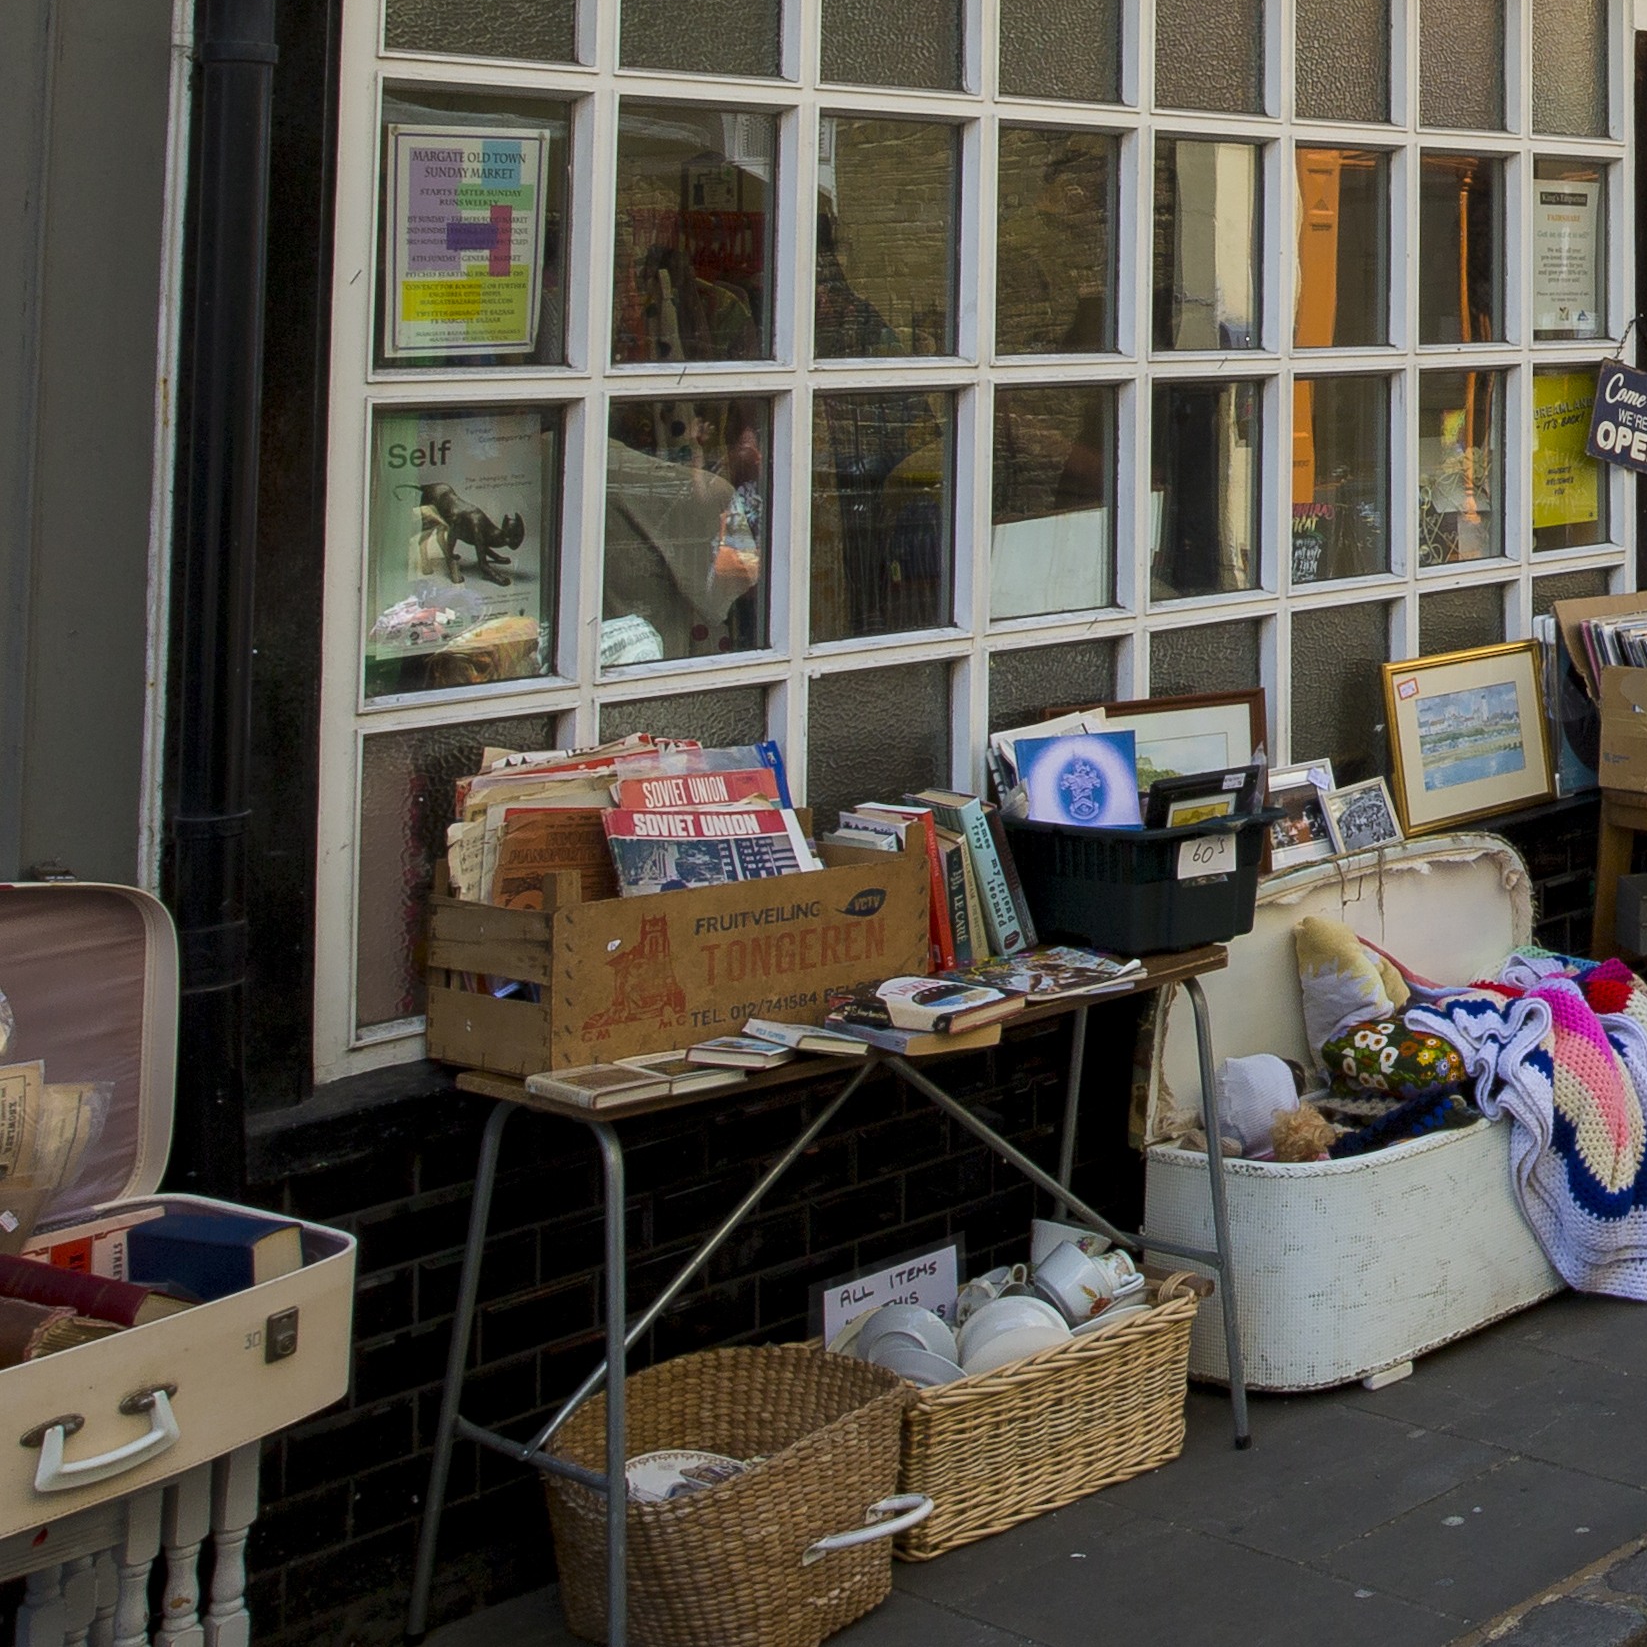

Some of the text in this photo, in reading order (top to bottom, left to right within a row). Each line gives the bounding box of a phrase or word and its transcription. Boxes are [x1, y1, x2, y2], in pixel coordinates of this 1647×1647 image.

[412, 151, 527, 164] MARGATE OLD TOWN
[424, 166, 515, 179] SUNDAY MARKET
[420, 187, 451, 196] STARTS
[486, 189, 522, 197] SUNDAY
[1605, 372, 1647, 408] Come
[387, 439, 452, 470] Self
[641, 774, 729, 809] SOVIET UNION
[632, 811, 761, 837] SOVIET UNION
[970, 824, 984, 851] frey
[975, 815, 992, 850] James
[953, 893, 965, 910] LE
[986, 880, 1008, 929] leonard
[991, 858, 1016, 923] my friend
[694, 901, 821, 936] FRUITVEILING
[700, 917, 886, 987] TONGEREN
[691, 1010, 726, 1028] TEL.
[730, 990, 818, 1021] 012/741584
[840, 1260, 938, 1308] ALL ITEMS
